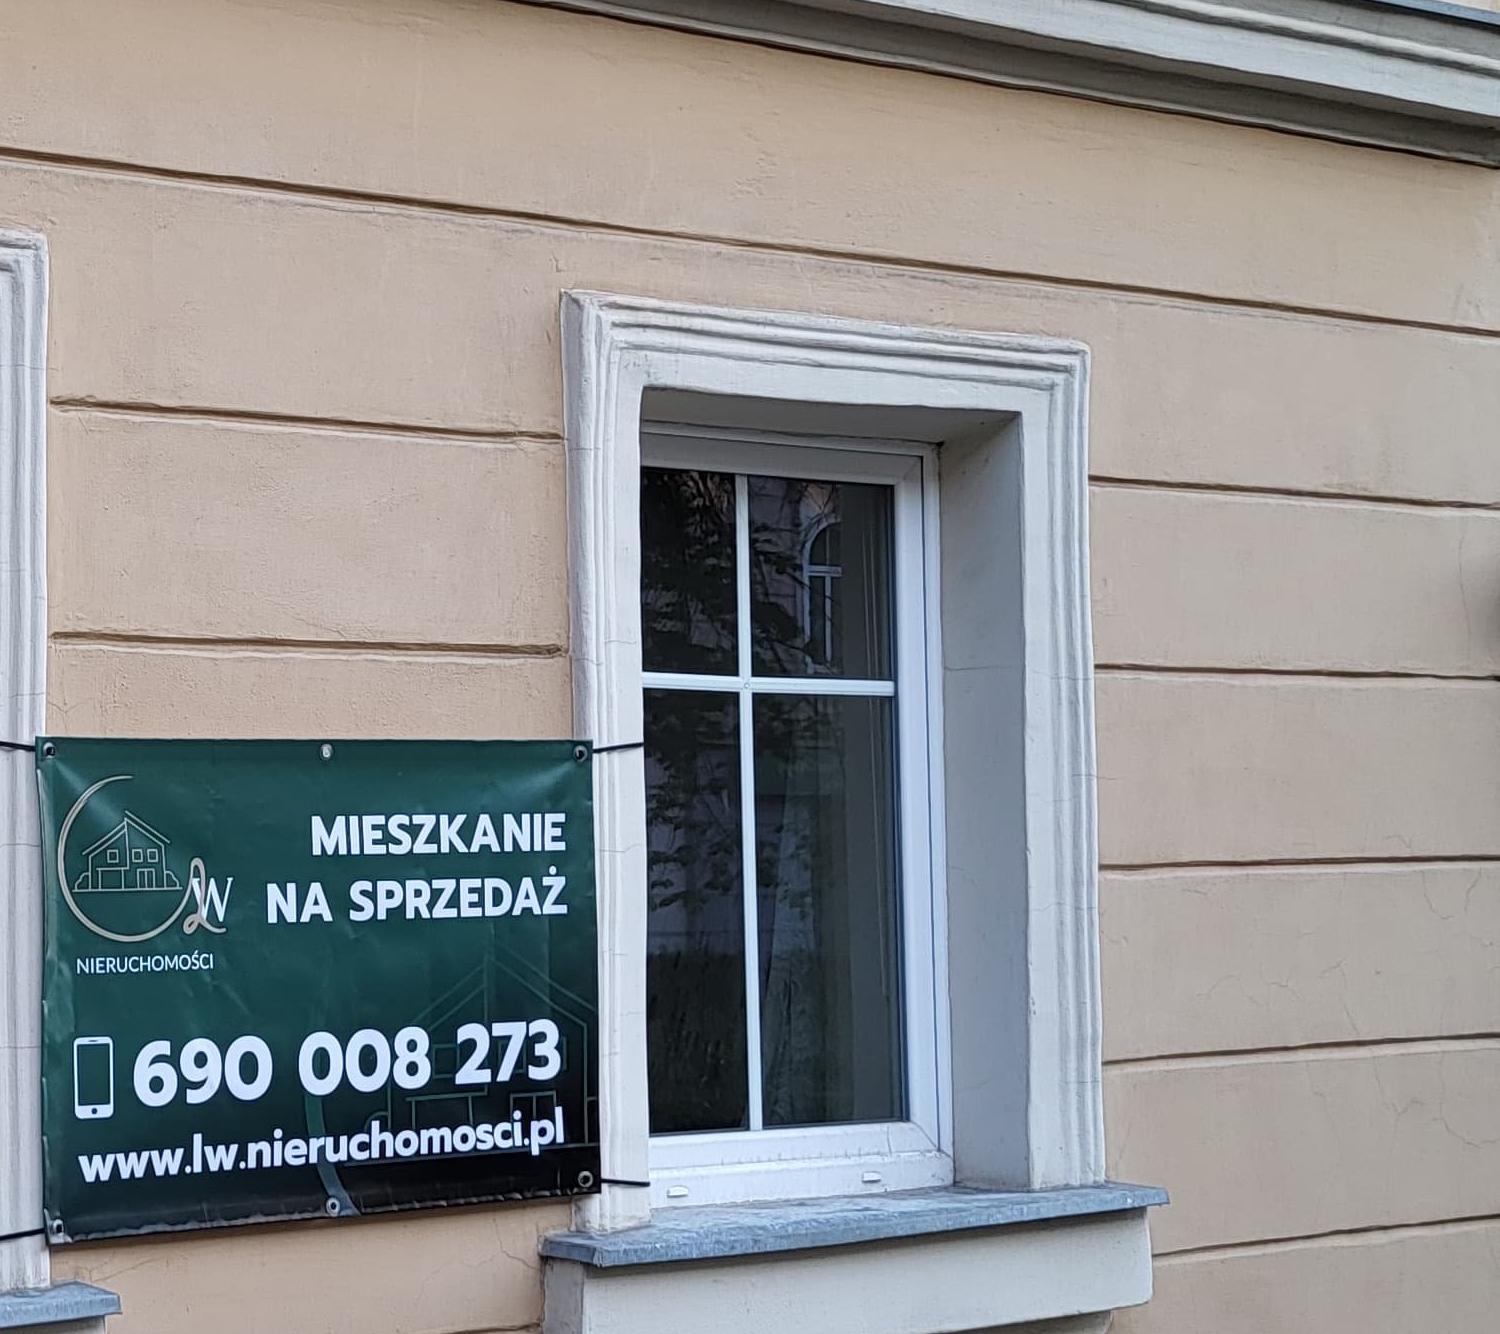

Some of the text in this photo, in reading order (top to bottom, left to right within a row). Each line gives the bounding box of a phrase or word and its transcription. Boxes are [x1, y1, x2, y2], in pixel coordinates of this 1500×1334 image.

[311, 812, 566, 855] MIESZKANIE
[266, 865, 568, 924] NA SPRZEDAŻ
[76, 949, 214, 975] NIERUCHOMOŚCI
[132, 1018, 562, 1107] 690 008 273
[78, 1107, 565, 1183] www.lw.nieruchomosci.pl
